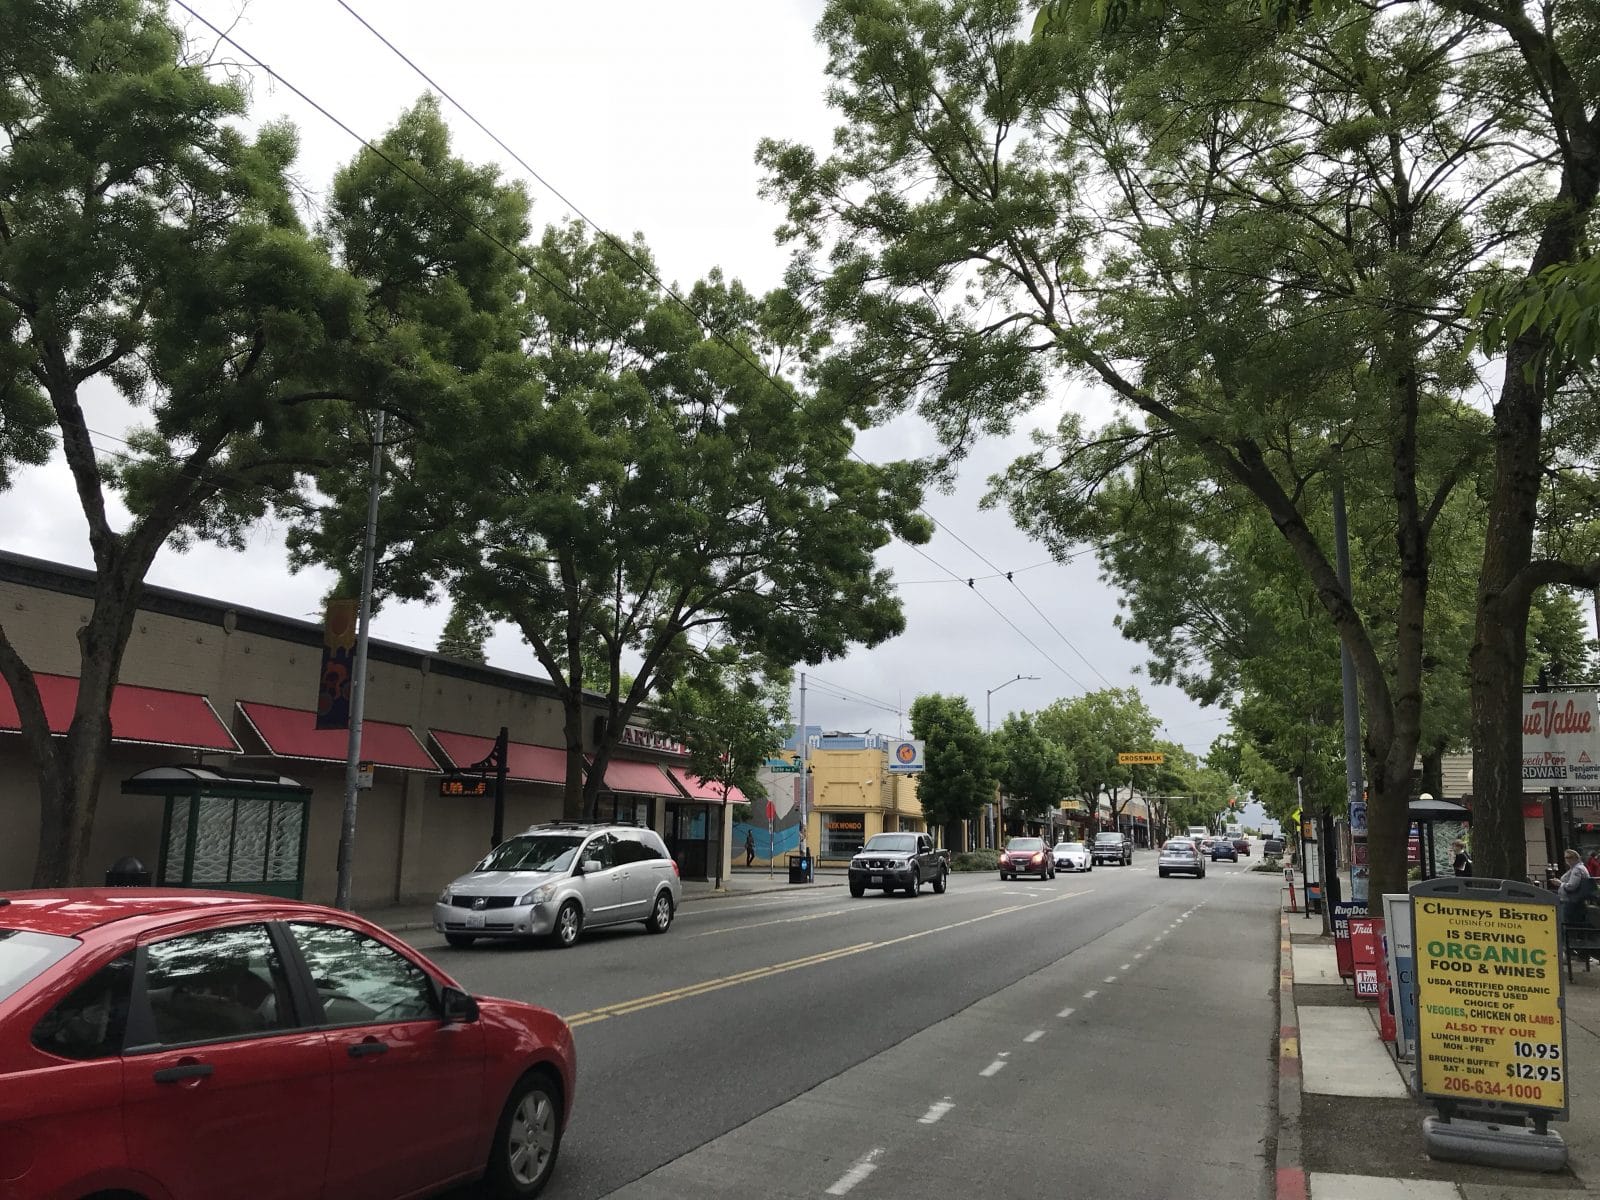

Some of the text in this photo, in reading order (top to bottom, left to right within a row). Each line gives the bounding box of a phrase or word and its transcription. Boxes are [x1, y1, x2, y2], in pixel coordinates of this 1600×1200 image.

[1523, 699, 1591, 738] ue Value
[623, 727, 679, 752] ARTELL
[1523, 755, 1543, 768] eedy
[1523, 767, 1566, 778] RDWARE
[1335, 906, 1368, 916] RugDoc
[1335, 920, 1348, 928] RE
[1449, 919, 1482, 927] CUISINE
[1336, 930, 1350, 938] HE
[1447, 930, 1526, 944] IS SERVING
[1427, 941, 1547, 966] ORGANIC
[1430, 960, 1546, 979] FOOD & WINES
[1427, 977, 1550, 995] USDA CERTIFIED ORGANIC
[1449, 987, 1529, 1000] PRODUCTS USED
[1463, 999, 1515, 1010] CHOICE OF
[1426, 1005, 1555, 1025] VEGGIES, CHICKEN OR LAMB
[1445, 1022, 1536, 1038] ALSO TRY OUR
[1431, 1032, 1496, 1045] LUNCH BUFFET
[1443, 1042, 1463, 1050] MON
[1514, 1041, 1560, 1059] 10.95
[1428, 1054, 1500, 1068] BRUNCH BUFFET
[1443, 1064, 1459, 1072] SAT
[1466, 1067, 1484, 1075] SUN
[1506, 1063, 1561, 1081] $12.95
[1444, 1077, 1542, 1100] 206-634-1000
